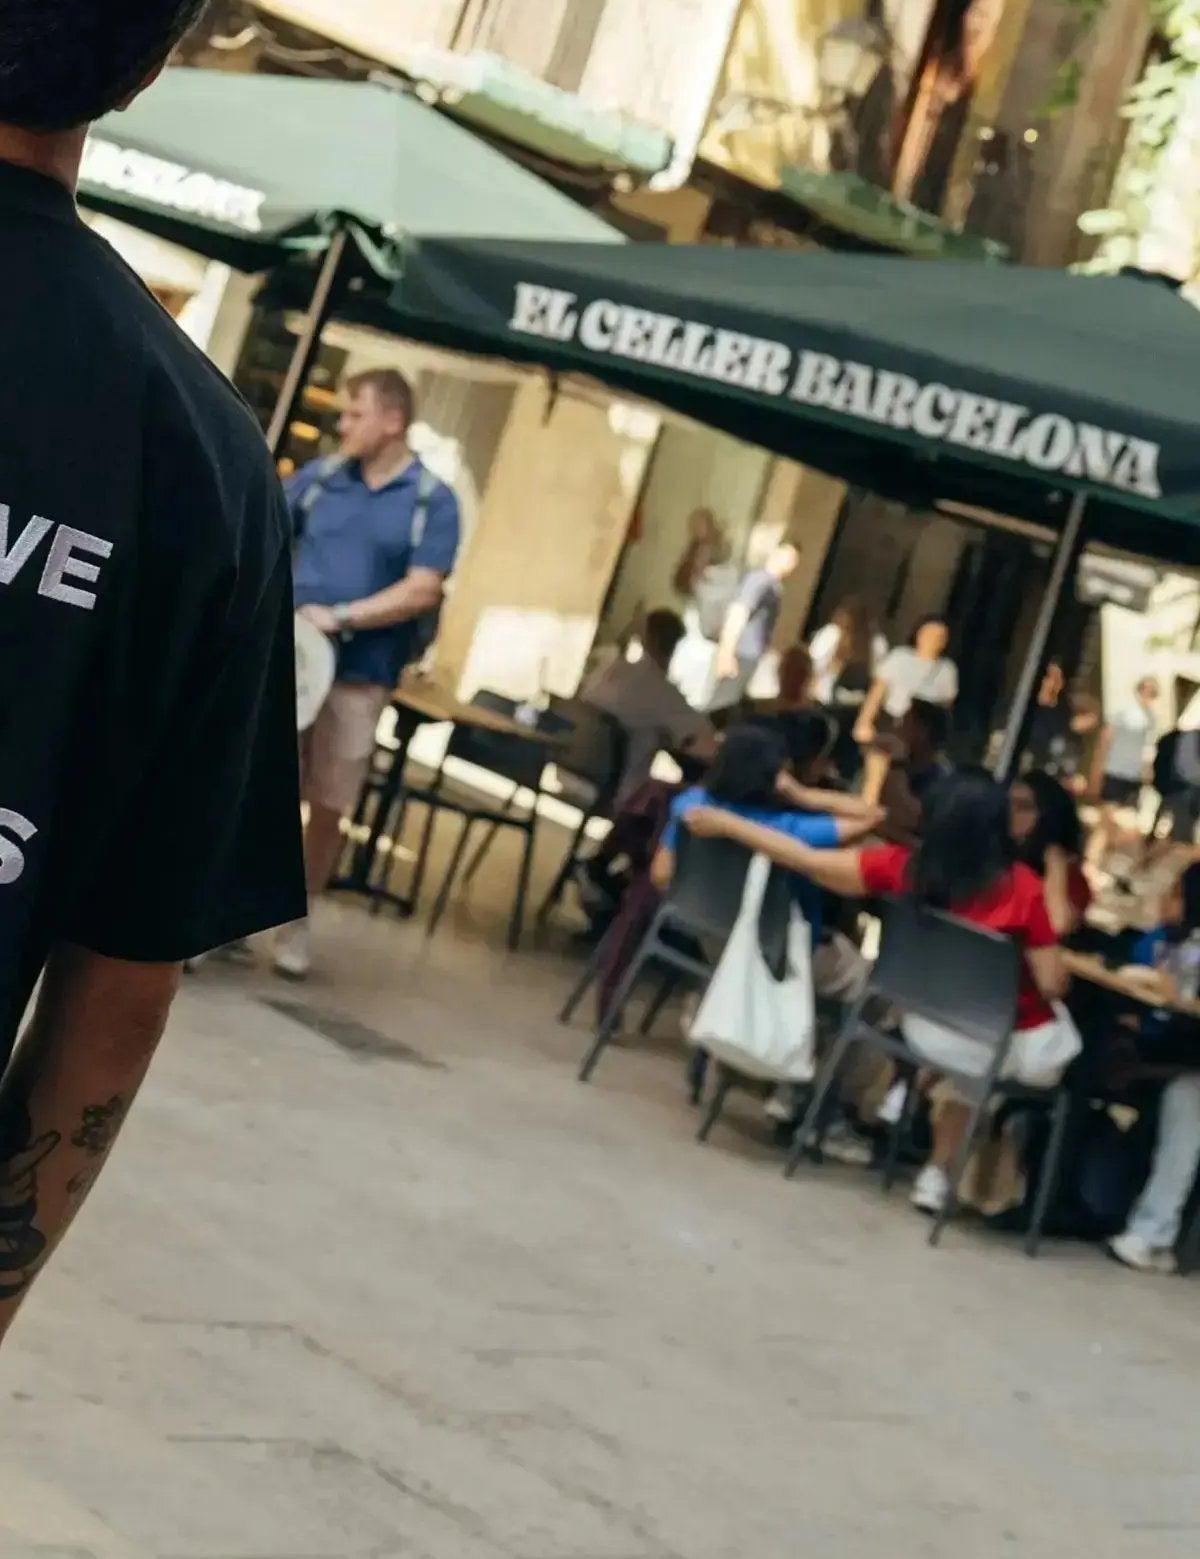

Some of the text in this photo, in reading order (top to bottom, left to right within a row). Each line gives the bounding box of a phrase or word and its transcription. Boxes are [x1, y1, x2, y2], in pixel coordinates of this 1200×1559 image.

[509, 281, 1162, 498] EL CELLER BARCELONA
